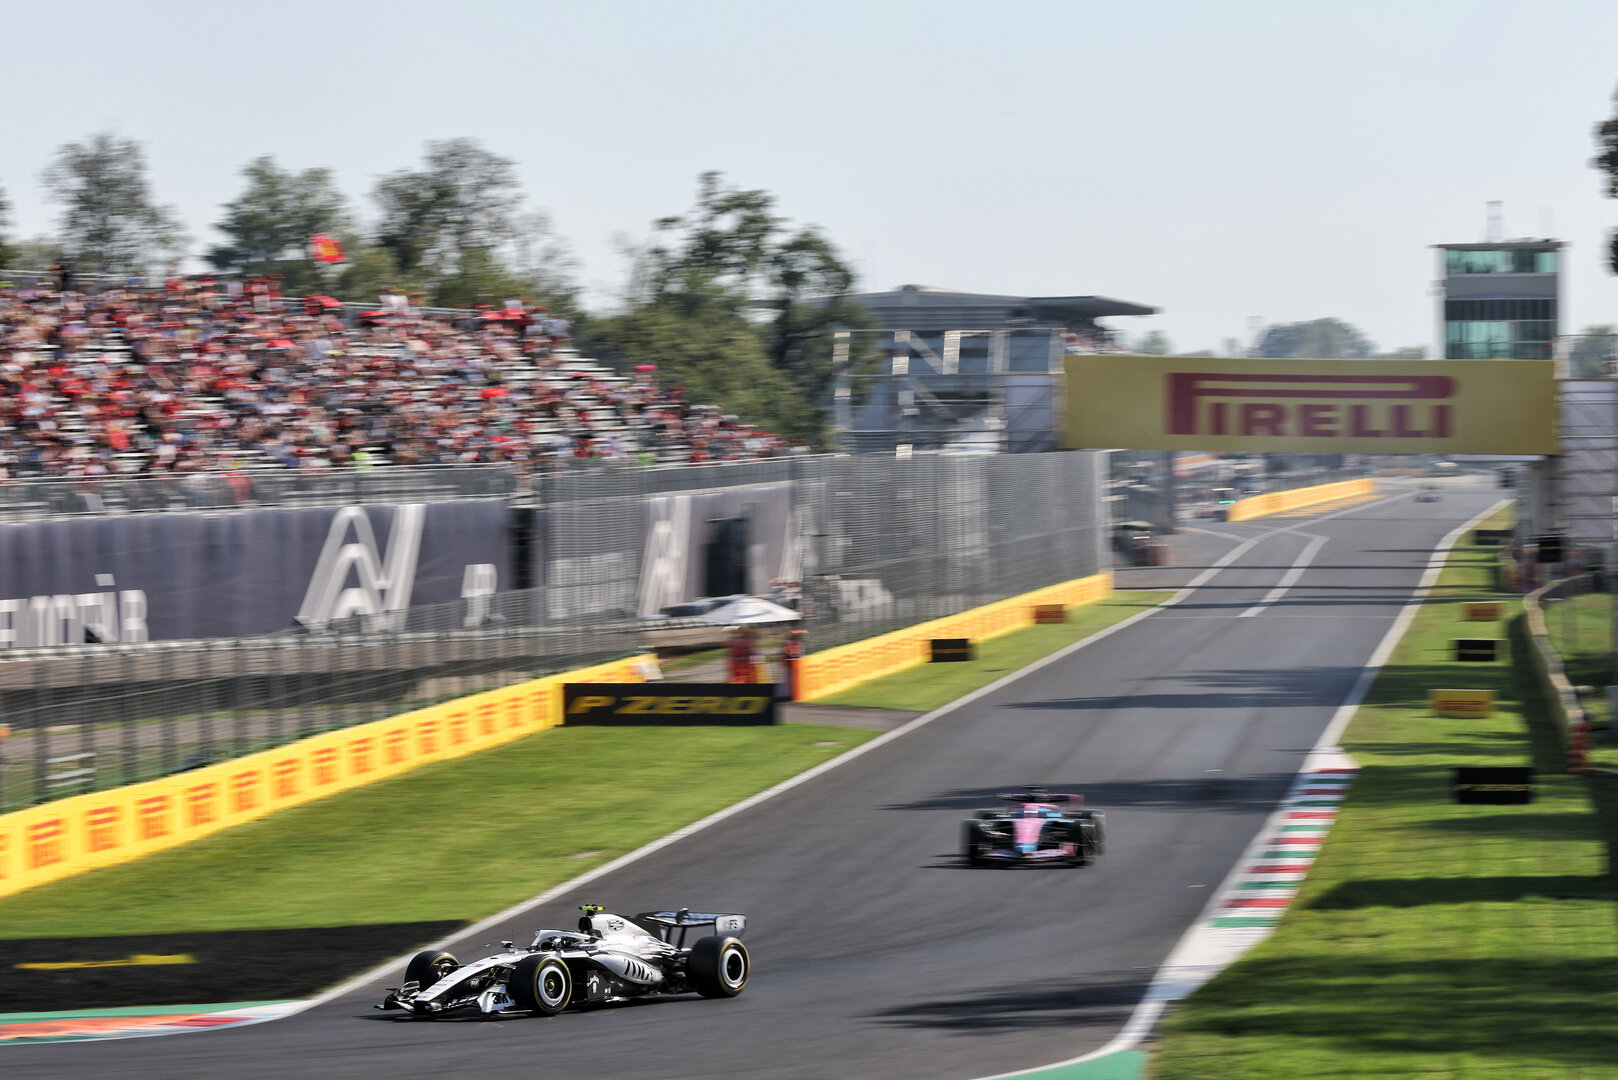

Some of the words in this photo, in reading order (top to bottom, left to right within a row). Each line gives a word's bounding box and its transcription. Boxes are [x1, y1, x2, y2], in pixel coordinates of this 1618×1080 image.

[1164, 372, 1460, 438] PIRELLI
[567, 696, 616, 714] P
[614, 696, 771, 714] ZERO
